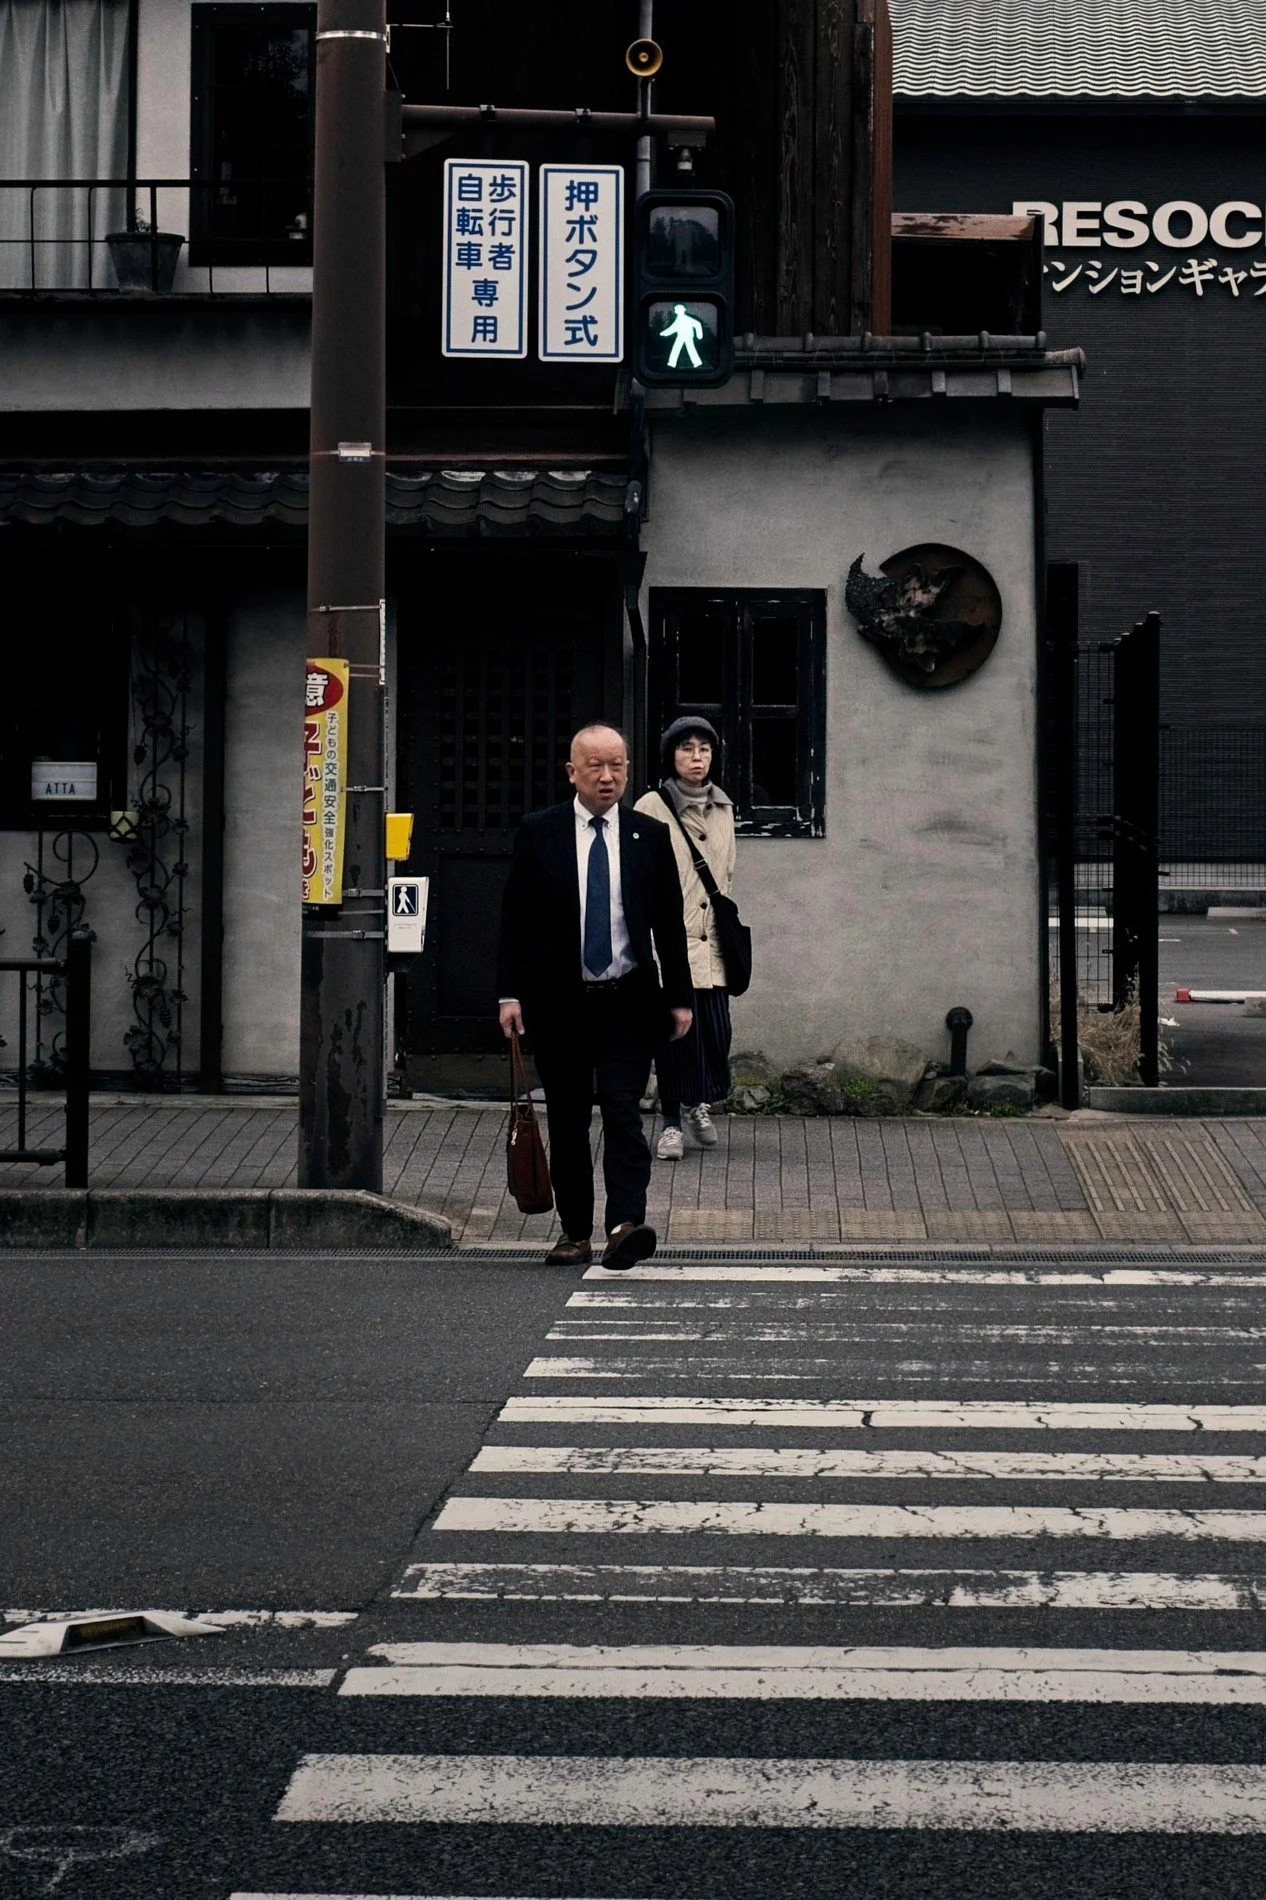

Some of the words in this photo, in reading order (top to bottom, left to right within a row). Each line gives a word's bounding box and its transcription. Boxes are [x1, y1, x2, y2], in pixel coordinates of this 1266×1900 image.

[455, 173, 484, 270] 自転車
[488, 174, 517, 271] 歩行者
[1012, 200, 1266, 248] RESOC
[563, 179, 599, 347] 押ボタン式
[1043, 258, 1266, 297] ンションギャラ
[471, 277, 499, 344] 専用
[45, 783, 75, 794] ATTA
